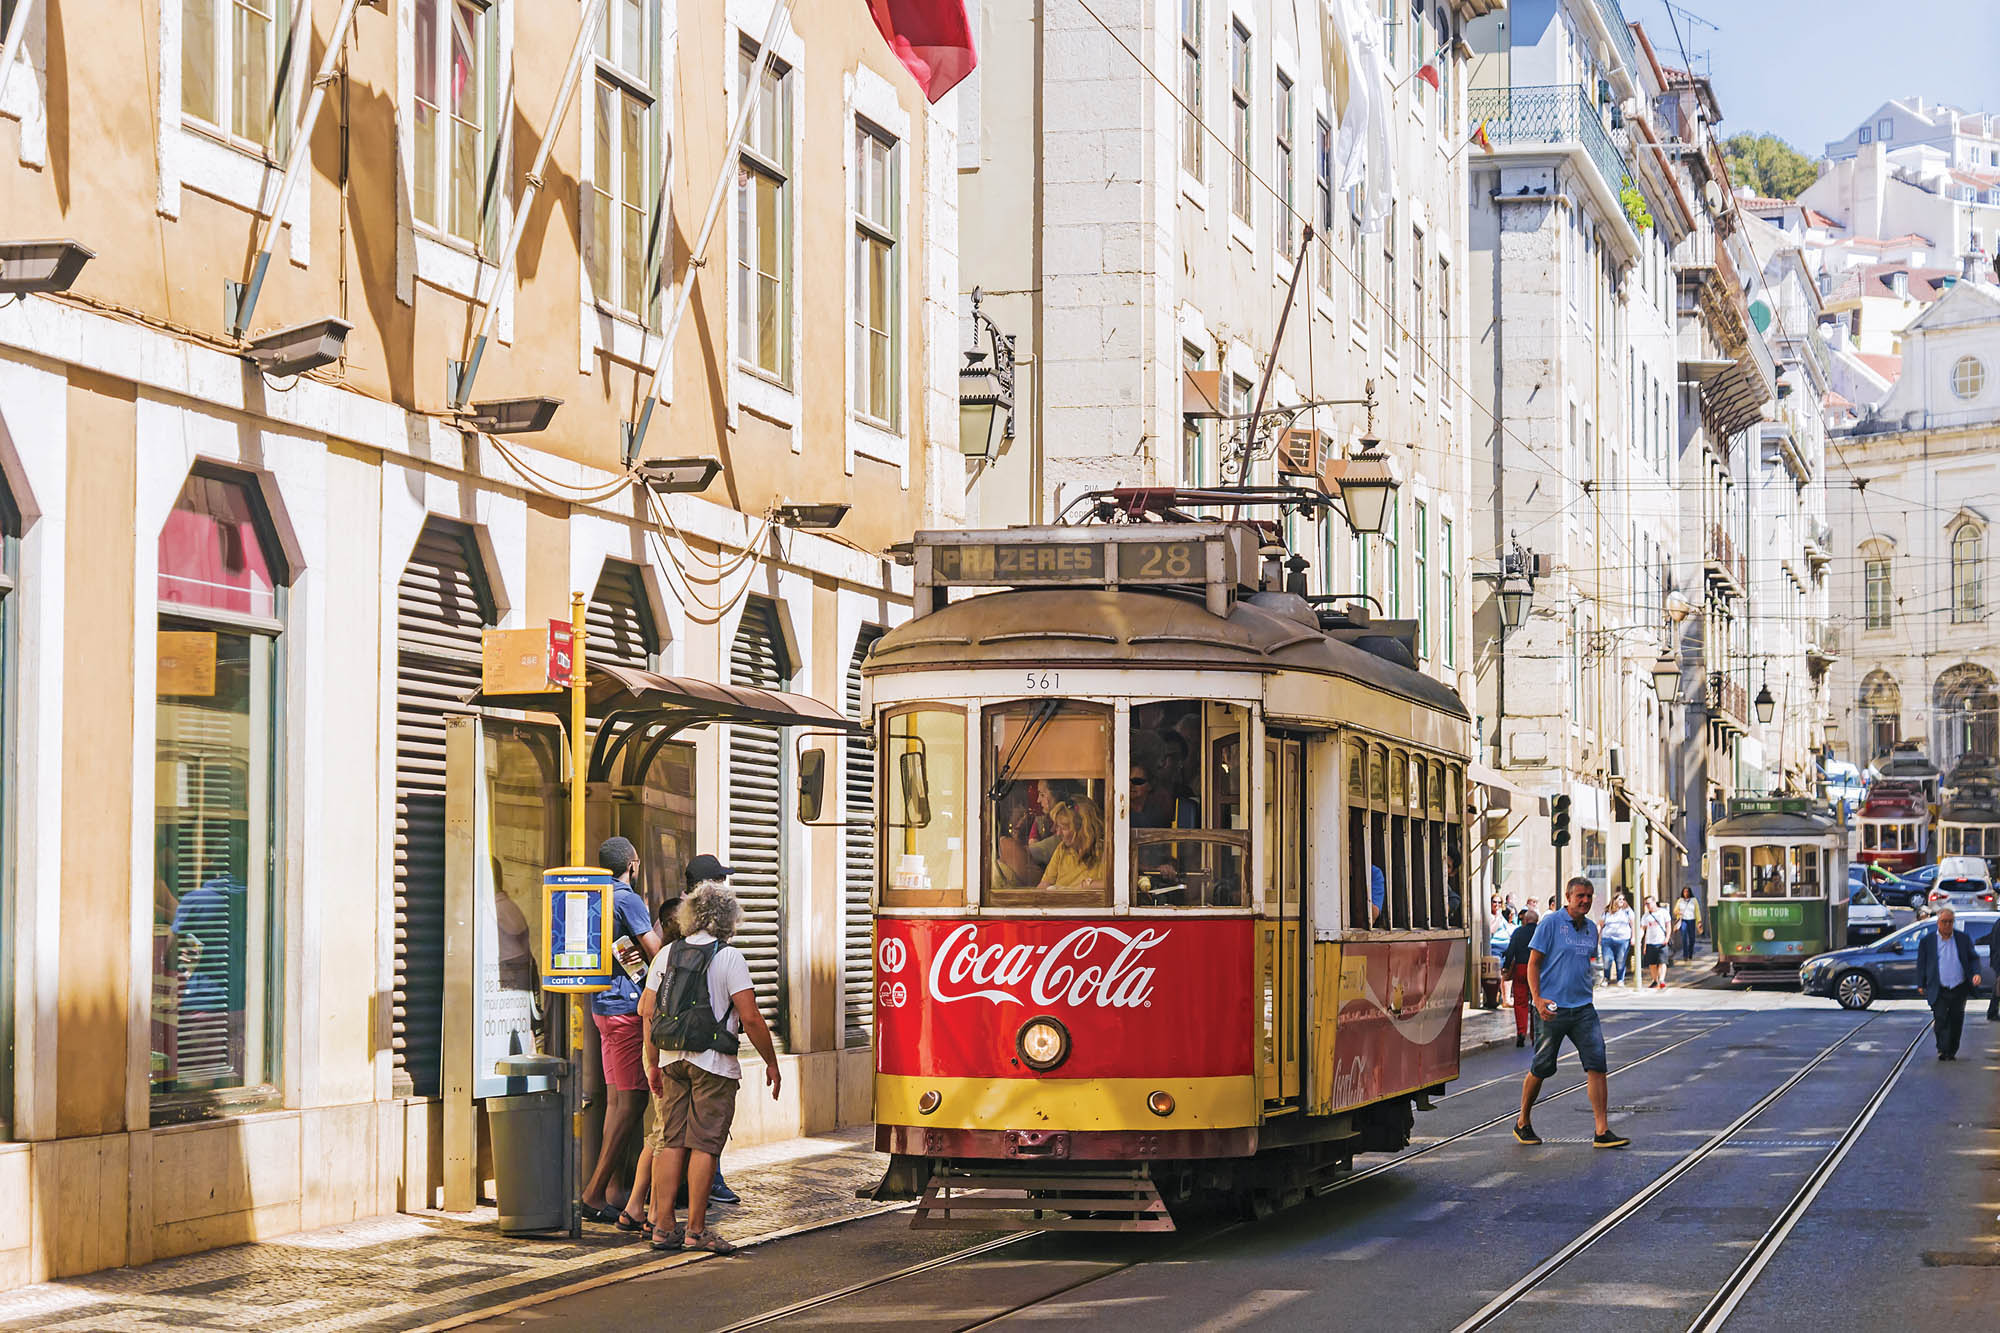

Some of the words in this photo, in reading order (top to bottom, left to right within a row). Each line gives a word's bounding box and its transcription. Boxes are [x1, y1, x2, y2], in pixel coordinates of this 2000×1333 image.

[943, 548, 1092, 572] PRAZERES
[1140, 546, 1191, 577] 28
[1025, 672, 1061, 689] 561
[1757, 802, 1772, 810] TOUR
[1770, 907, 1789, 917] TOUR
[929, 923, 1172, 1008] Coca-Cola
[551, 976, 574, 985] carris
